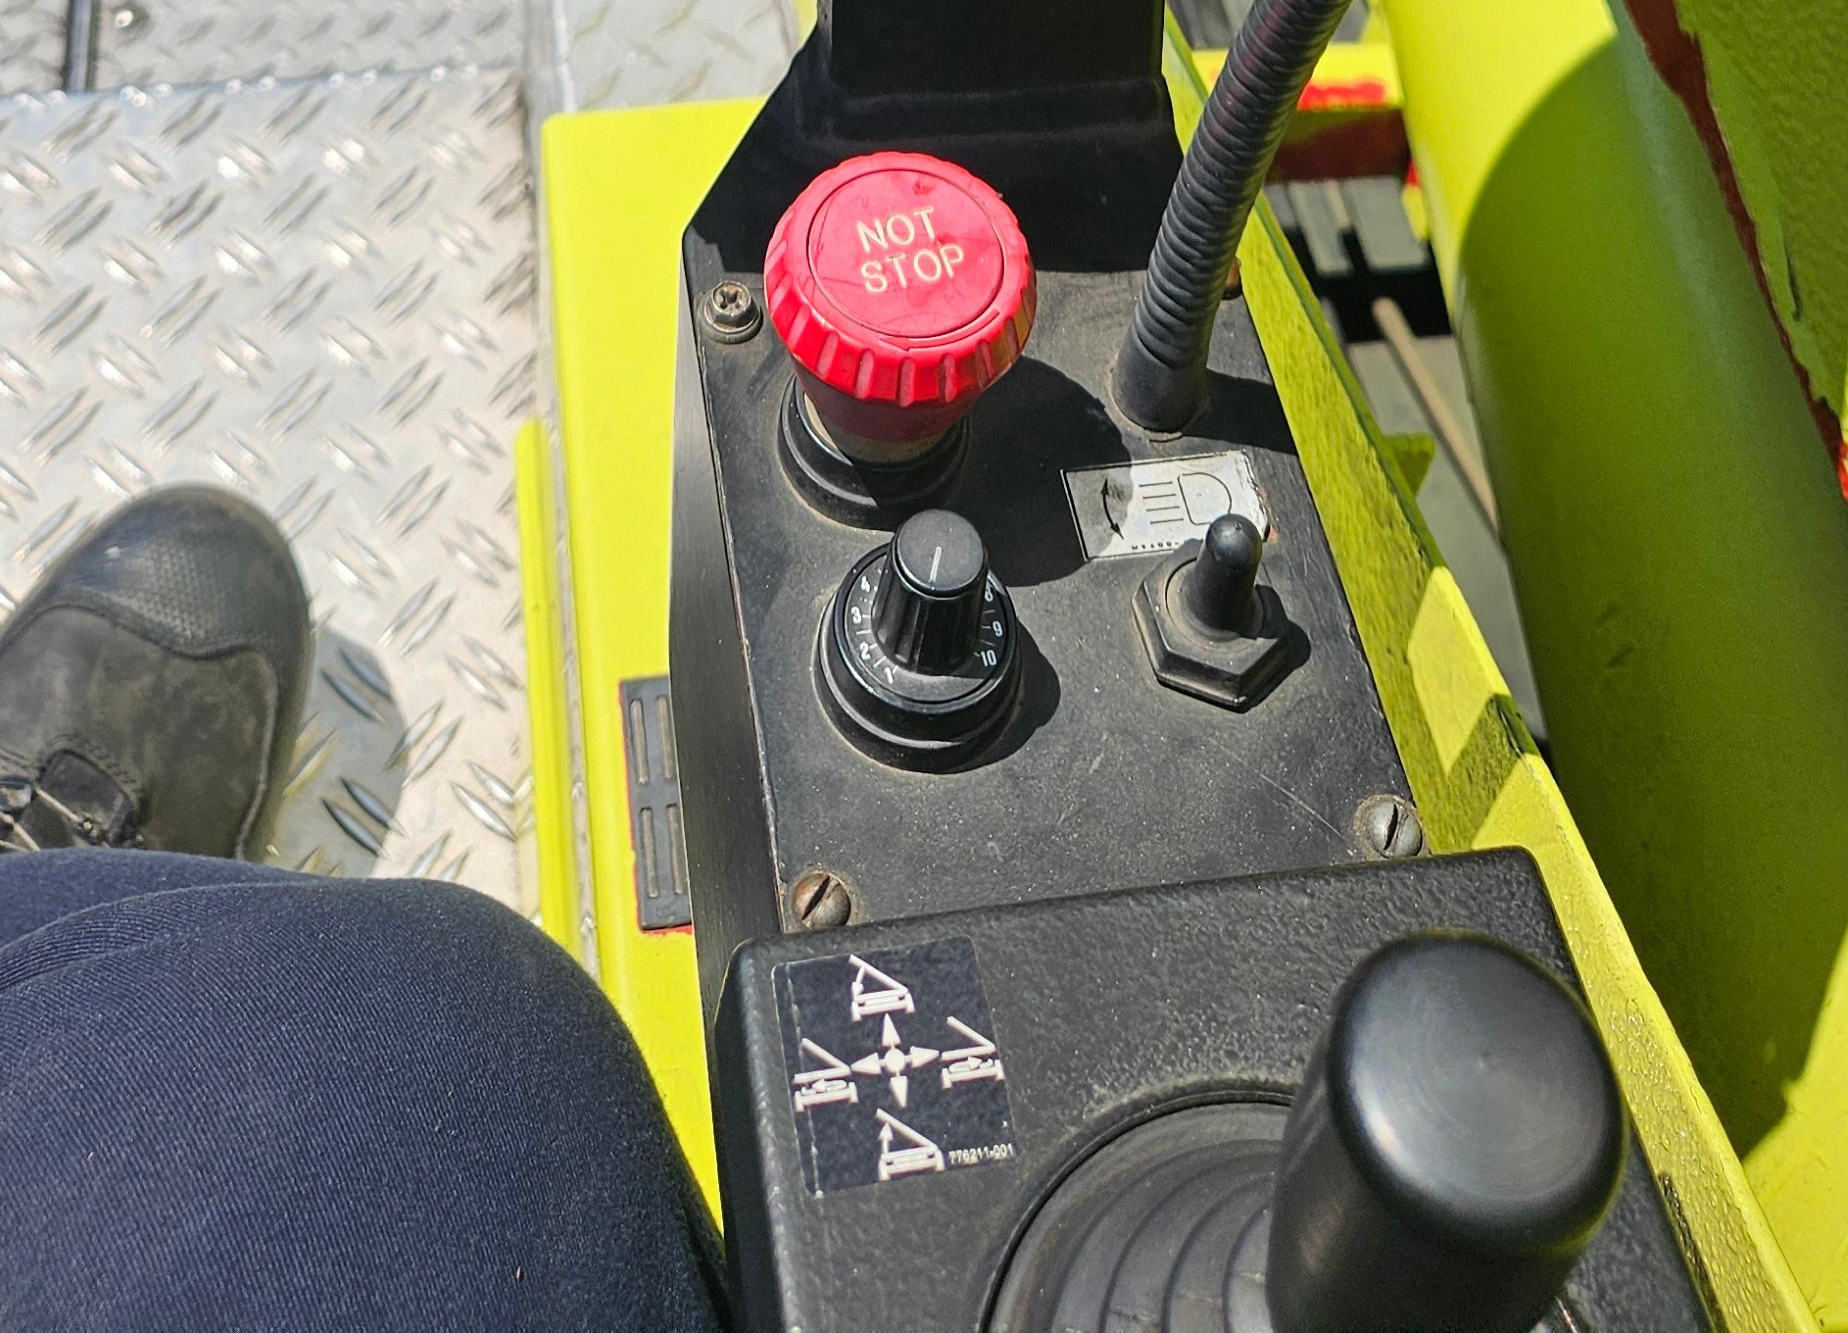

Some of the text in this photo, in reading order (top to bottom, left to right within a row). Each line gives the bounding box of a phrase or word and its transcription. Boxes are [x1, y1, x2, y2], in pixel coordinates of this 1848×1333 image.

[856, 205, 935, 253] NOT
[860, 243, 964, 293] STOP
[851, 606, 862, 624] 3
[992, 620, 1003, 637] 9
[859, 641, 871, 661] 2
[980, 649, 998, 667] 10
[884, 667, 894, 684] 1
[949, 1143, 1014, 1165] 776211-001
